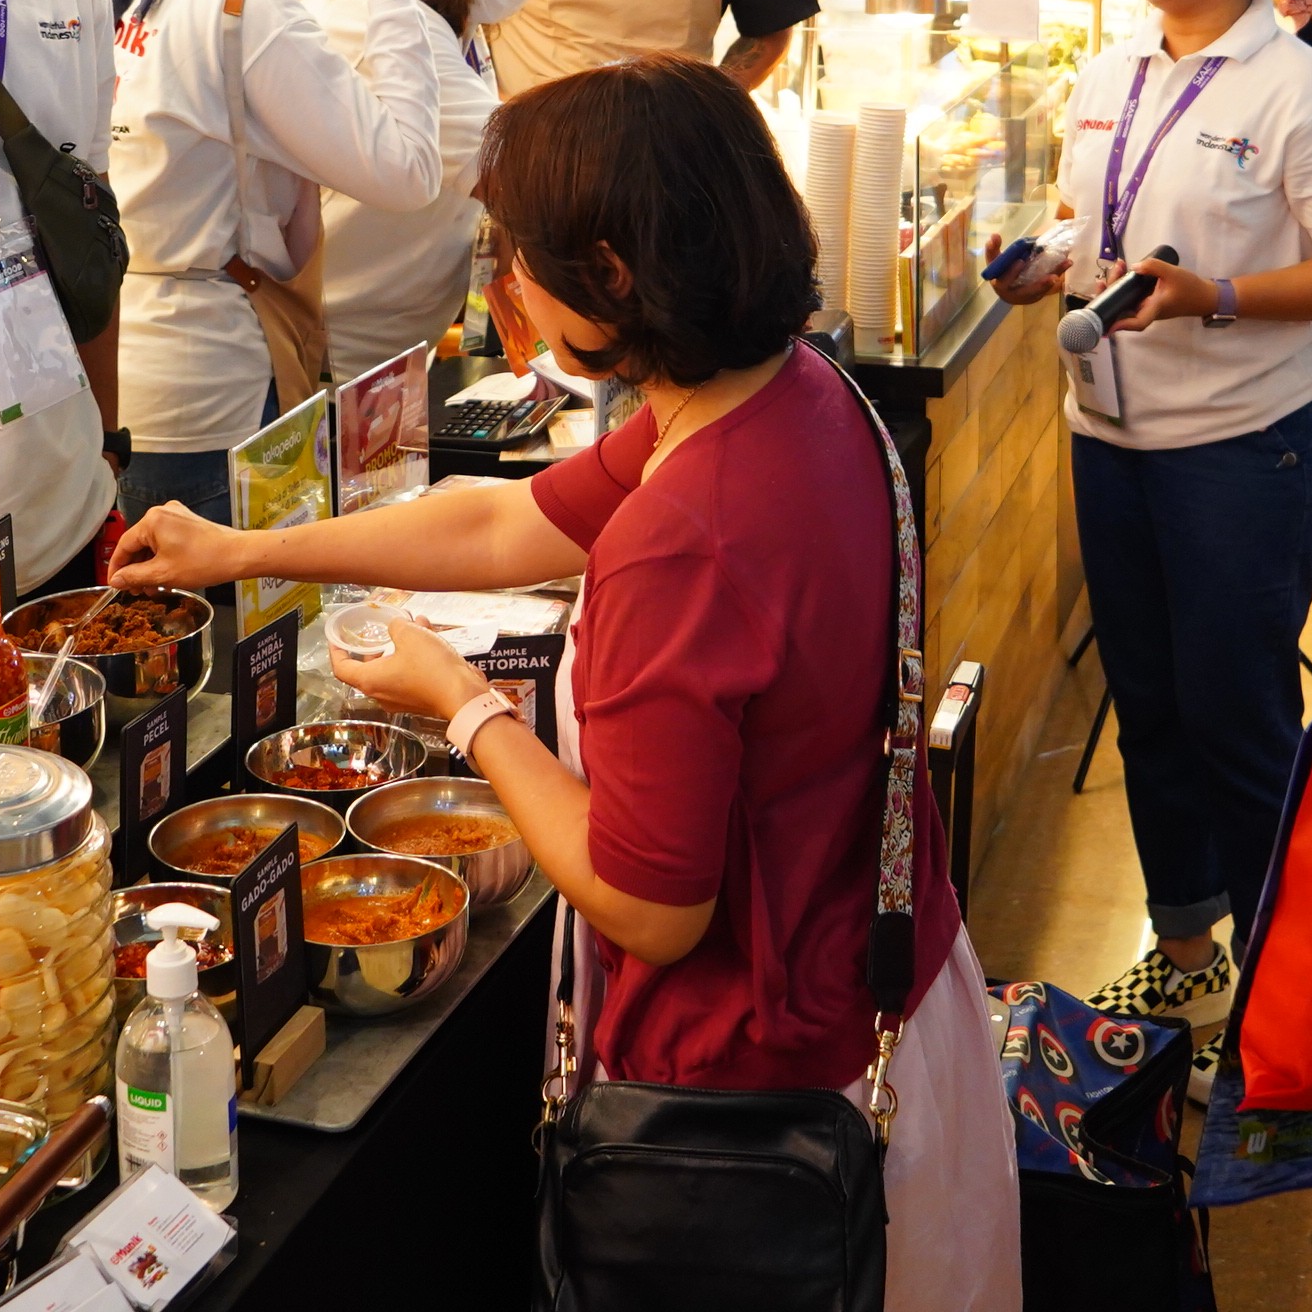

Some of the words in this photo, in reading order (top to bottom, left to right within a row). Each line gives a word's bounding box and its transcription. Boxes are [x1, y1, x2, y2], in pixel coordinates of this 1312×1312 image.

[262, 429, 302, 465] tokopedia
[365, 440, 398, 475] PROMO
[249, 638, 284, 666] SAMBAL
[257, 631, 278, 648] SAMPLE
[490, 647, 527, 658] SAMPLE
[249, 651, 283, 678] PENYET
[143, 720, 170, 748] PECEL
[146, 711, 167, 731] SAMPLE
[256, 853, 278, 880] SAMPLE
[241, 851, 294, 912] GADO-GADO
[130, 1093, 162, 1108] LIQUID
